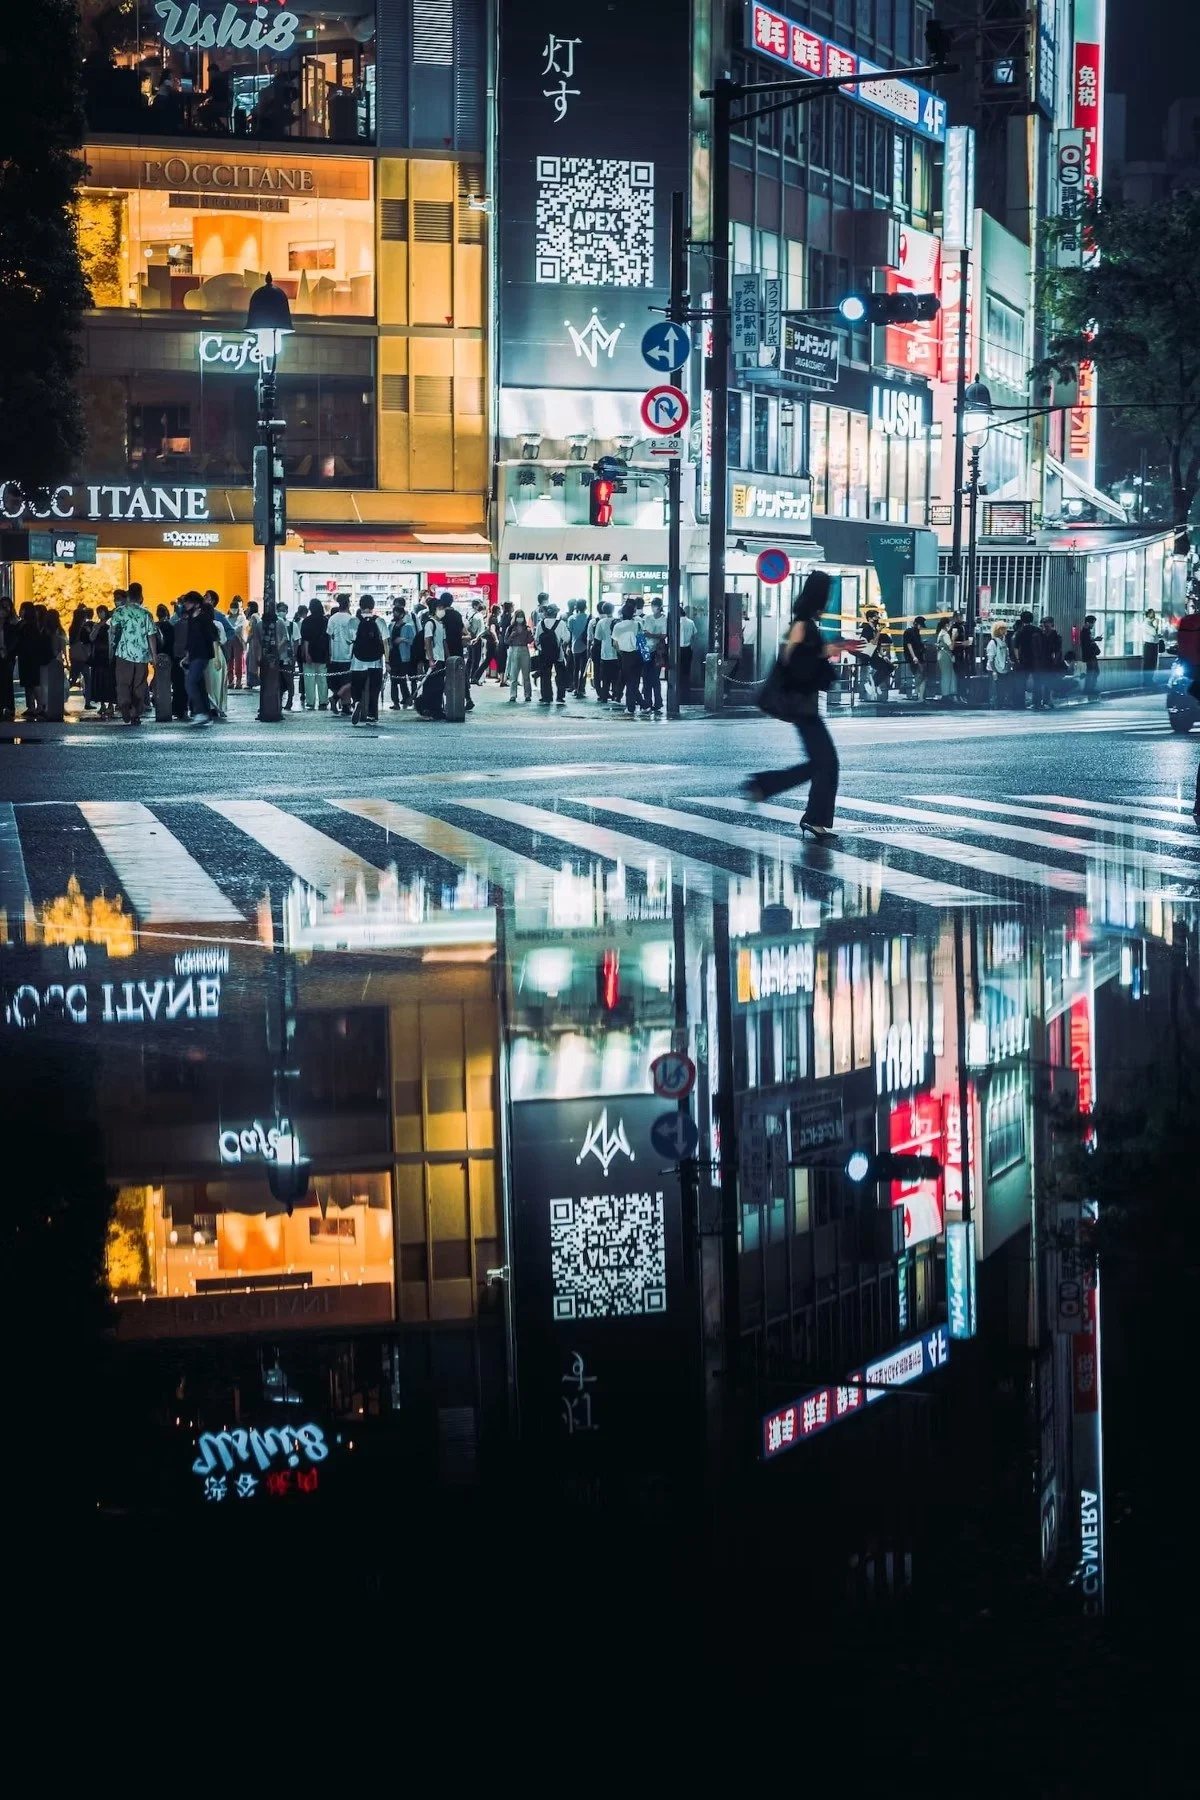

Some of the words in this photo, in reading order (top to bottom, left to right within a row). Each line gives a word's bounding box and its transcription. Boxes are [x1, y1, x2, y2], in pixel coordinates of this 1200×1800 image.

[155, 0, 299, 51] Ushi8
[541, 34, 582, 122] 灯す
[1079, 65, 1096, 107] 免税
[923, 96, 944, 135] 4F
[144, 157, 315, 192] L'OCCITANE
[1061, 148, 1080, 179] OS
[743, 280, 757, 347] 渋谷駅前
[872, 385, 923, 439] LUSH
[651, 440, 657, 448] 8
[668, 440, 679, 448] 20
[508, 552, 558, 561] SHIBUYA
[565, 553, 611, 562] EKIMAE
